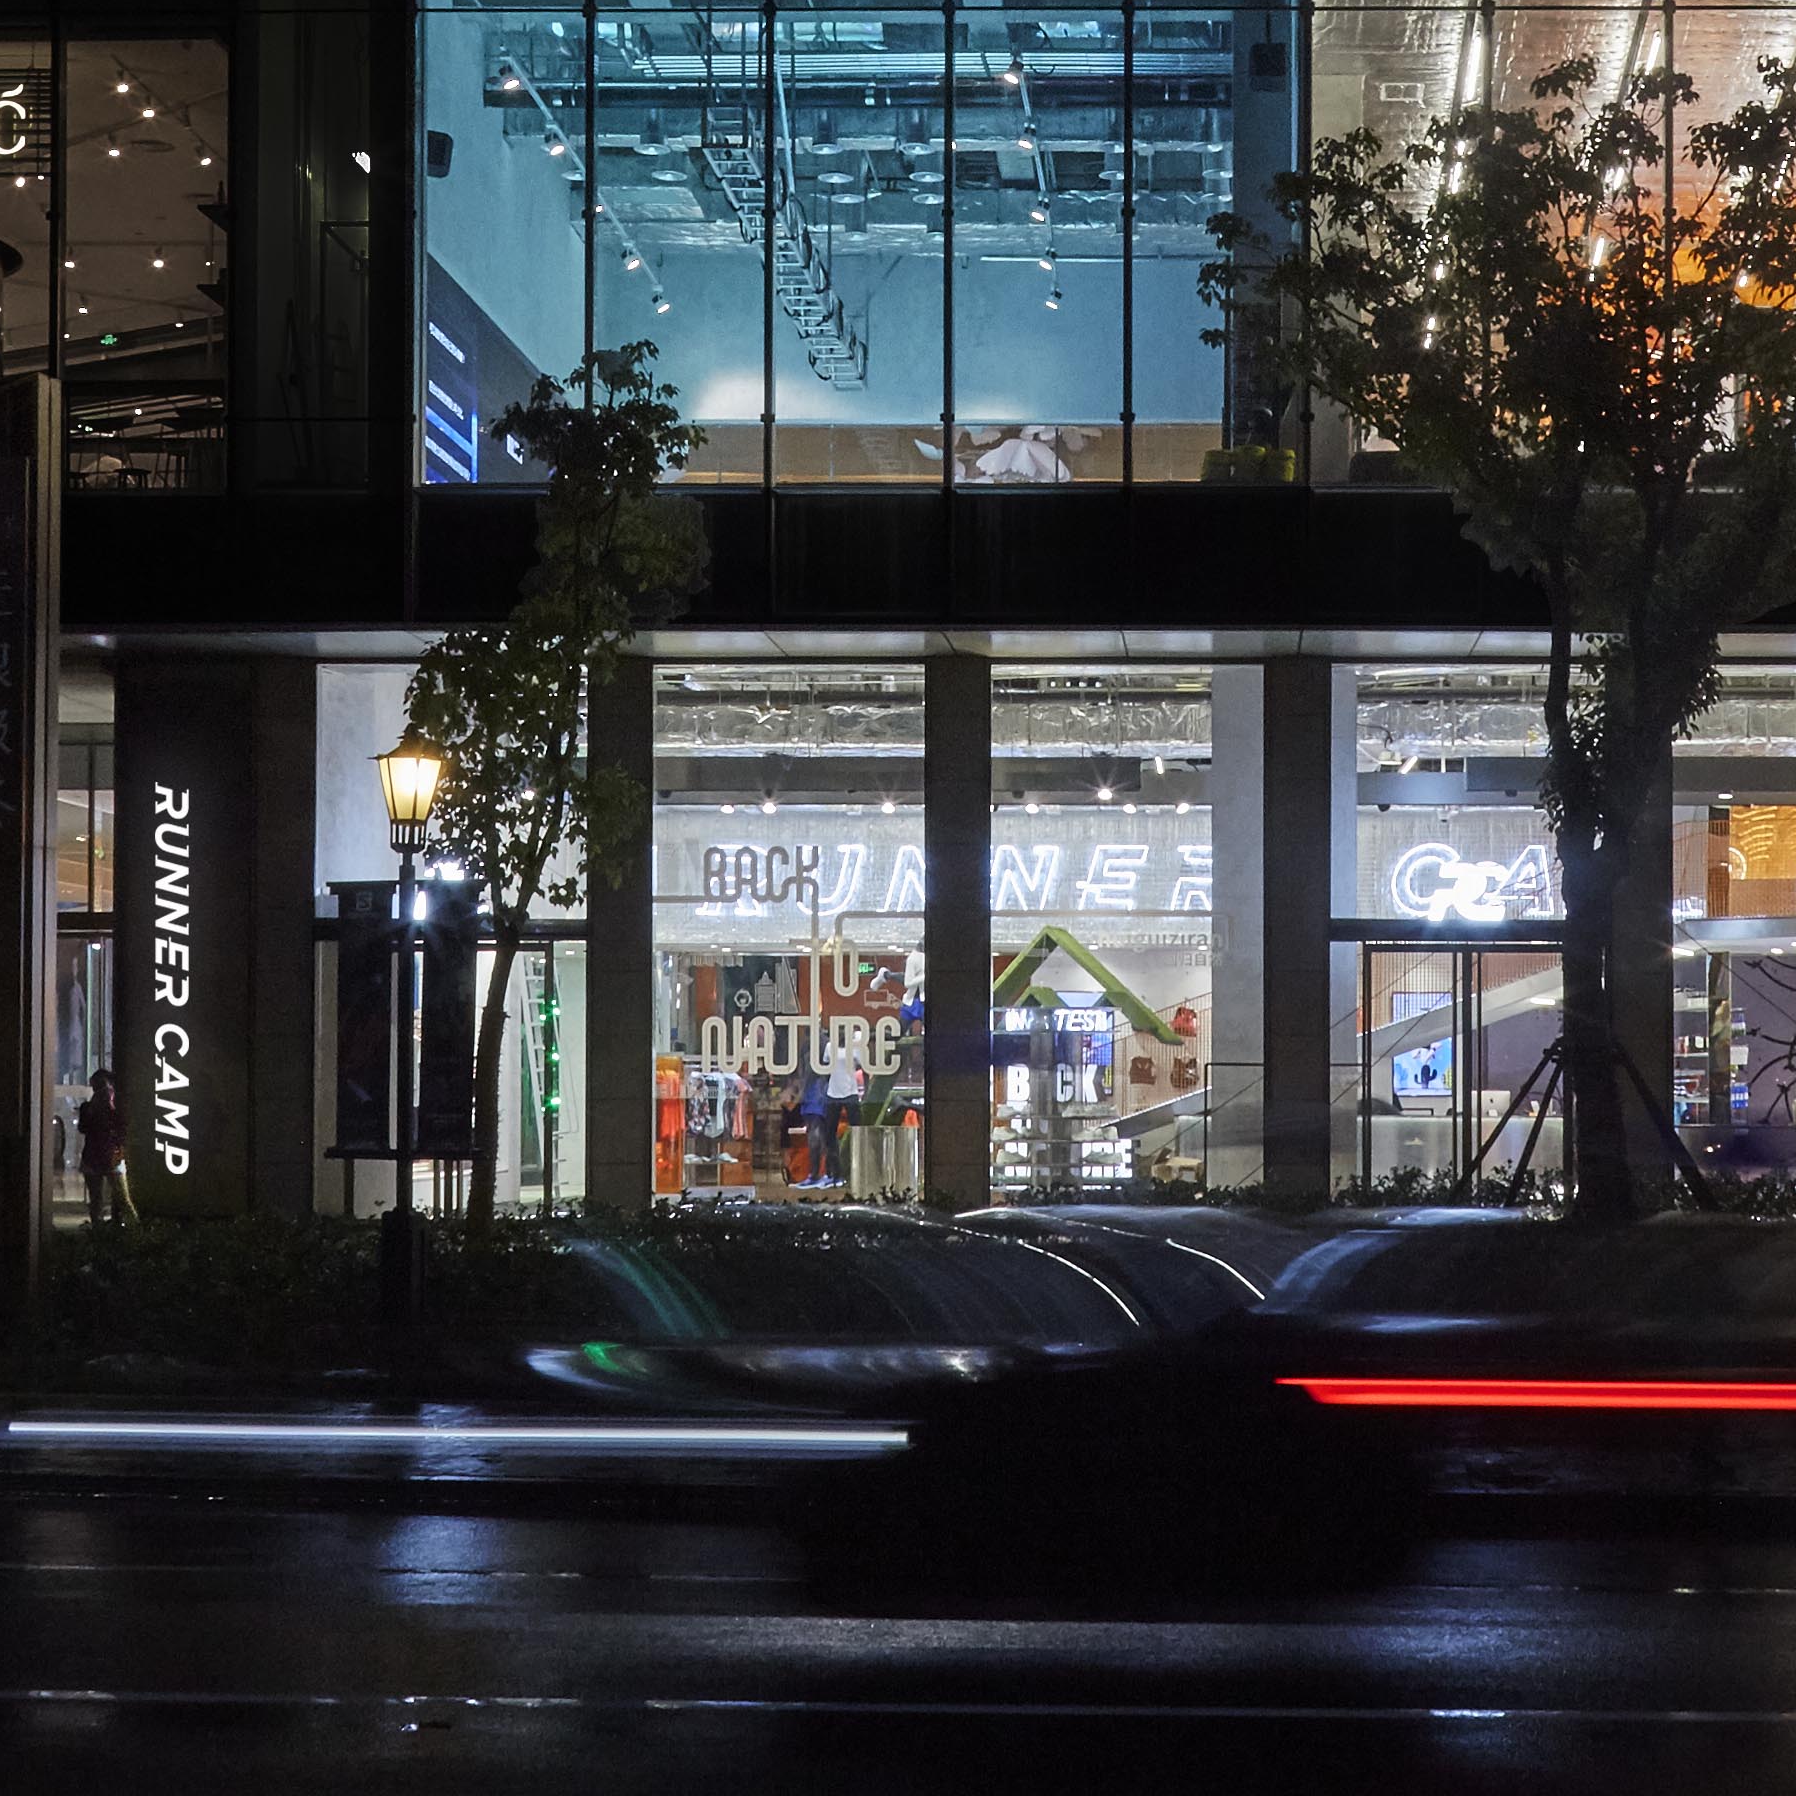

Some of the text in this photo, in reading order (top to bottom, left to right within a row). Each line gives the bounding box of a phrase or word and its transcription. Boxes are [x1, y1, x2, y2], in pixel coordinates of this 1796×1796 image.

[153, 780, 191, 1176] RUNNER CAMP
[701, 1015, 902, 1076] NATURE
[1006, 1063, 1099, 1103] BCK
